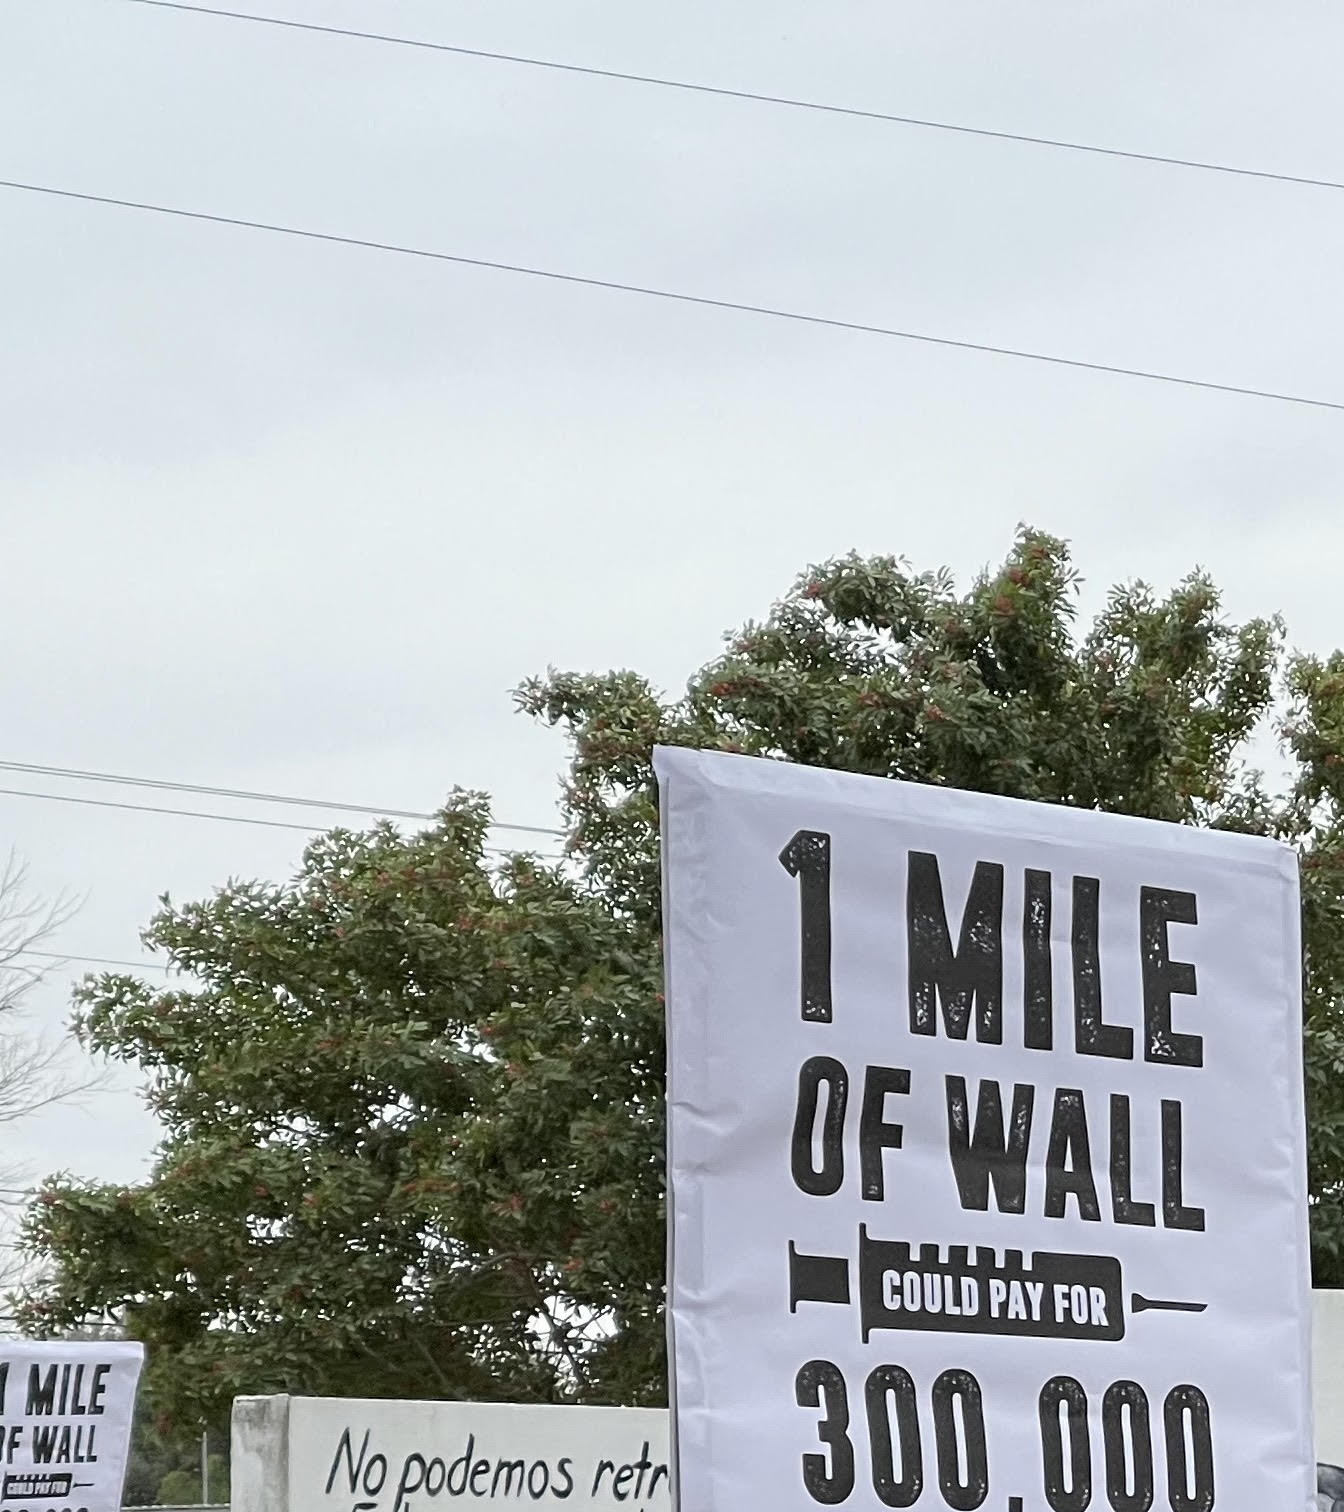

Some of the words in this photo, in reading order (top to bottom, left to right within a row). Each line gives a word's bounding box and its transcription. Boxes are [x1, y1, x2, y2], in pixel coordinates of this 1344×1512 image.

[778, 830, 833, 1023] 1
[907, 850, 1204, 1068] MILE
[790, 1056, 911, 1202] OF
[945, 1074, 1206, 1232] WALL
[882, 1269, 979, 1317] COULD
[988, 1278, 1044, 1321] PAY
[1053, 1284, 1110, 1327] FOR
[25, 1363, 112, 1415] MILE
[32, 1424, 98, 1464] WALL
[325, 1426, 388, 1498] No
[591, 1441, 672, 1501] retr
